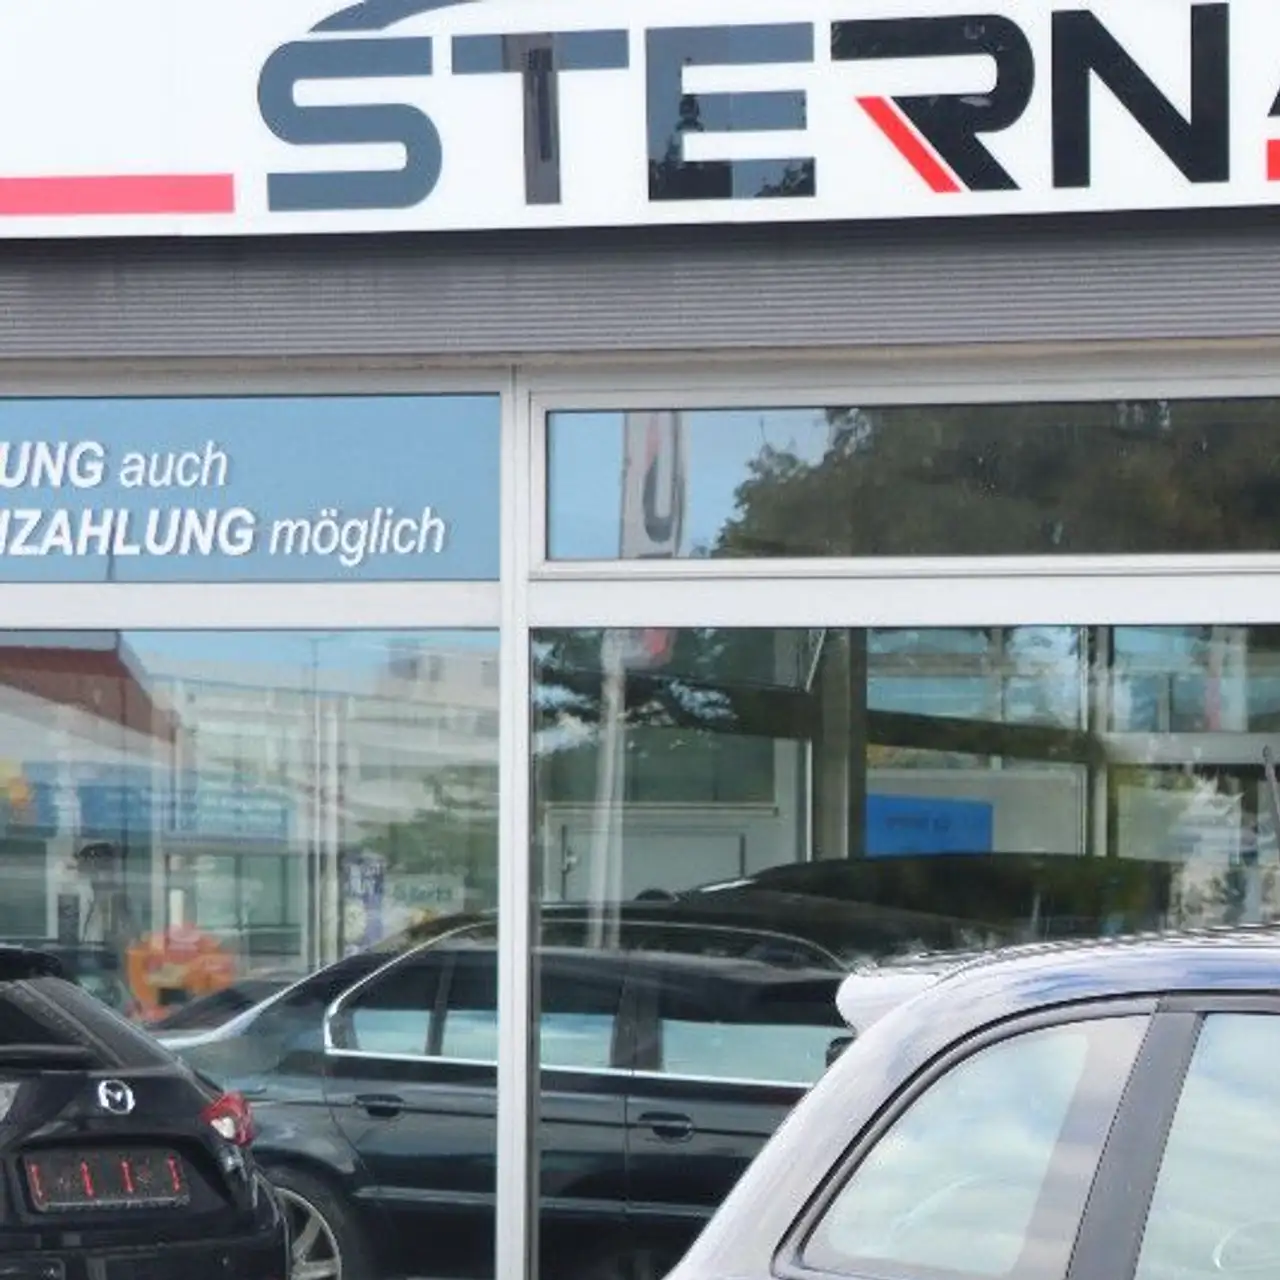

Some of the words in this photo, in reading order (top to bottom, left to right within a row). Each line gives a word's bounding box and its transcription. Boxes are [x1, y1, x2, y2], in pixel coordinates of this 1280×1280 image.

[256, 2, 1230, 212] STERN
[0, 440, 104, 488] UNG
[119, 440, 229, 488] auch
[0, 507, 256, 556] ZAHLUNG
[269, 506, 447, 566] möglich
